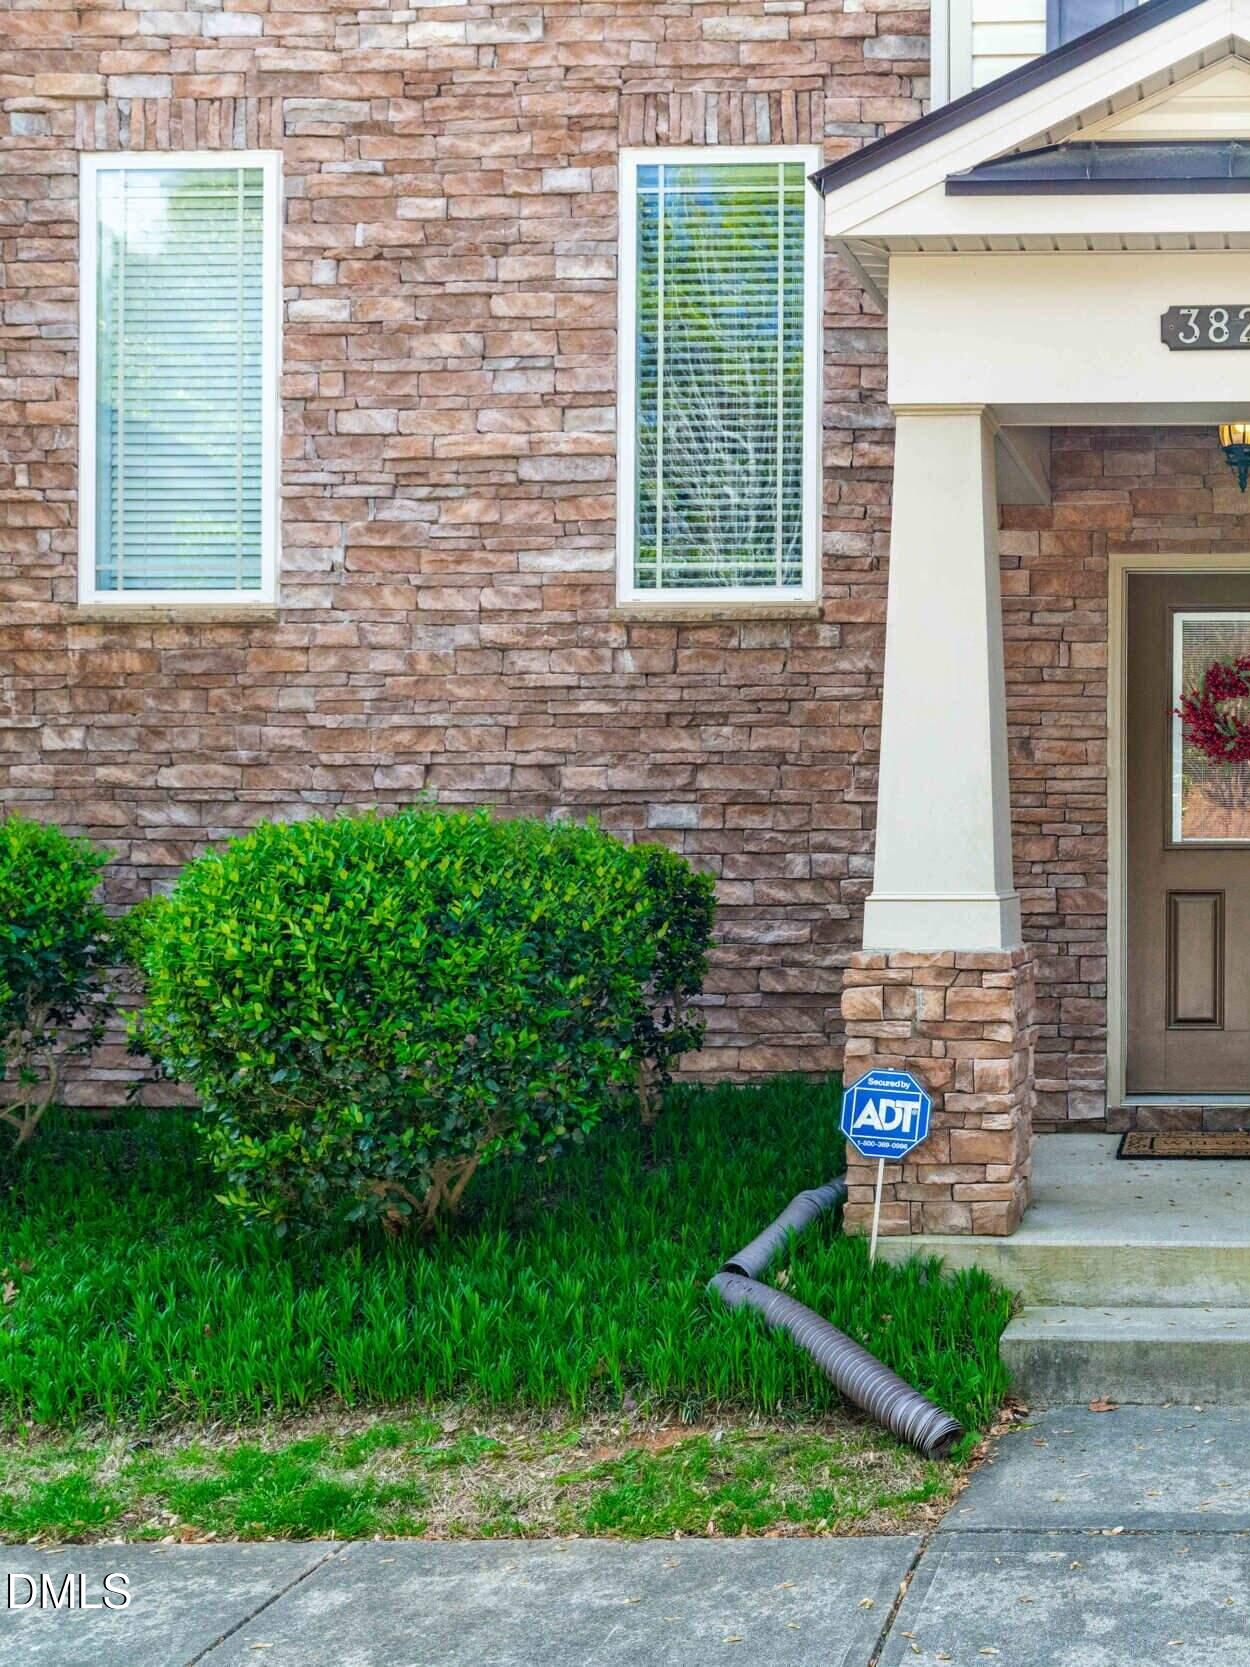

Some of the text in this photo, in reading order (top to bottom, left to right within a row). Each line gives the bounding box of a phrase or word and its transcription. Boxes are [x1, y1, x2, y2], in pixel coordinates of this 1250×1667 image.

[867, 1077, 911, 1090] Secured by
[853, 1098, 920, 1133] ADT
